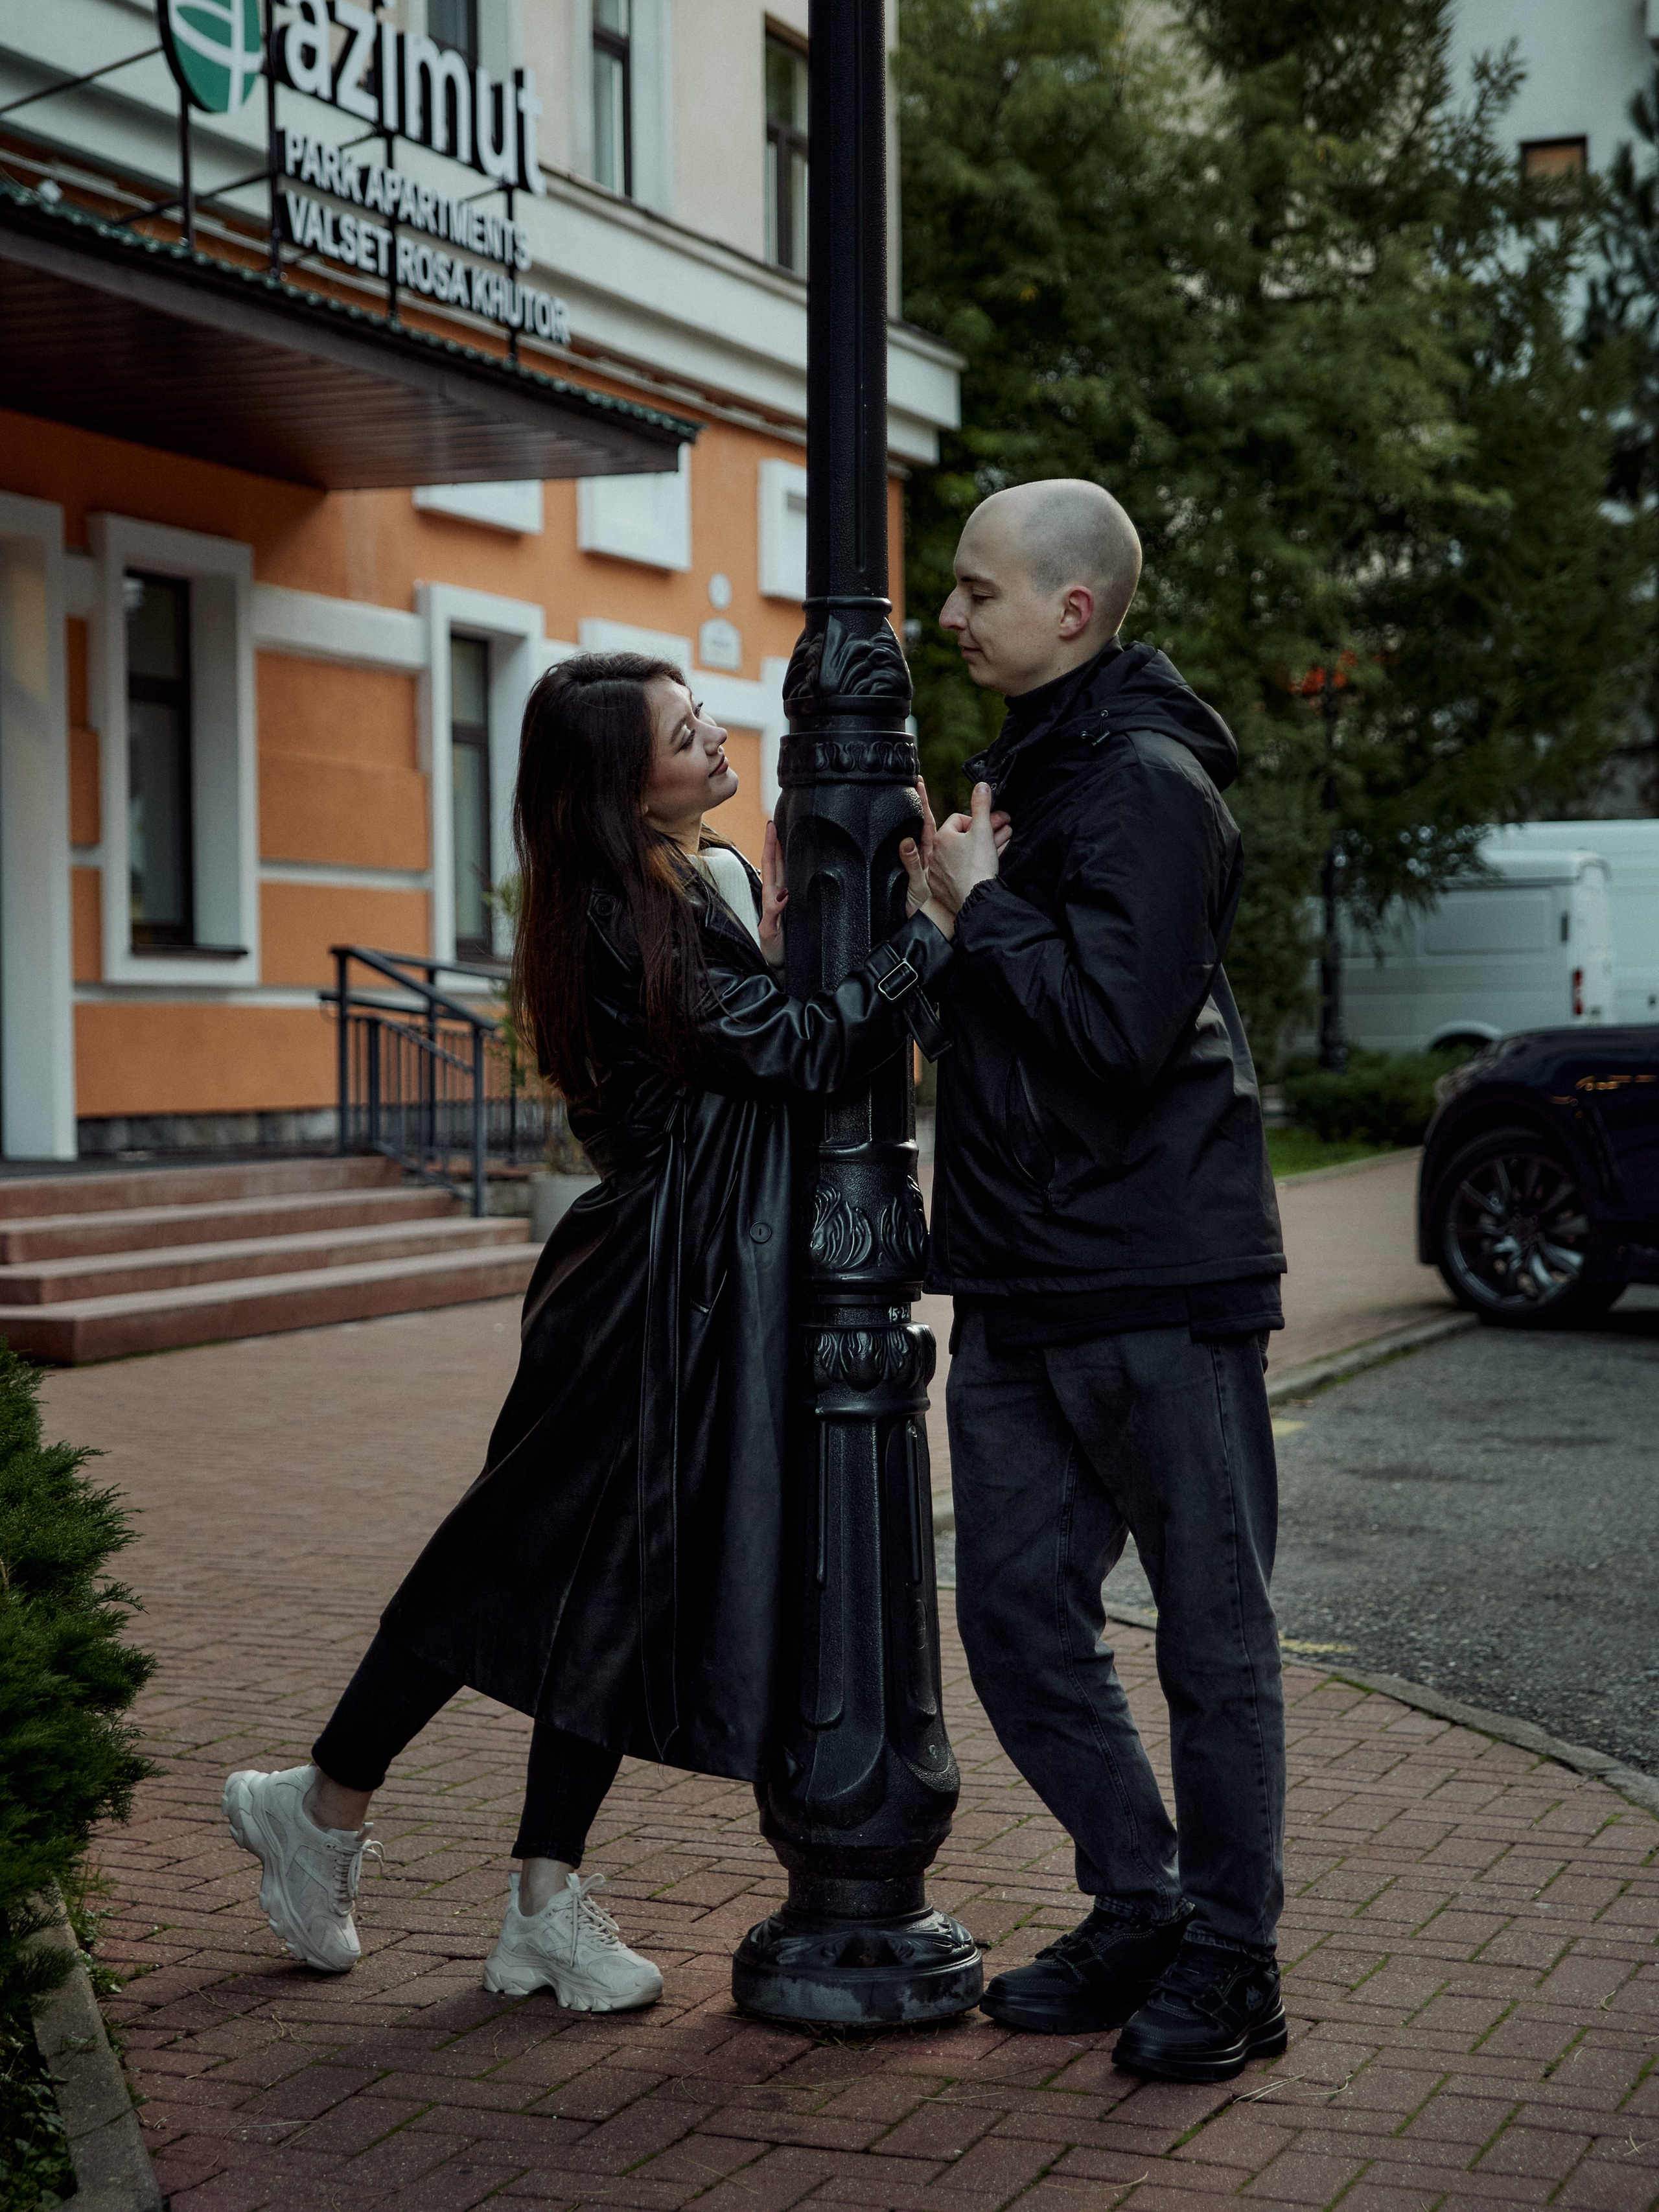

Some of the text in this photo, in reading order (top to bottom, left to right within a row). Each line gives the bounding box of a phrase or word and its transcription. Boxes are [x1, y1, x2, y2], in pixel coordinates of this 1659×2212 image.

[284, 0, 548, 195] azimut
[284, 132, 533, 272] PARK APARTMENTS
[285, 189, 571, 345] VALSET ROSA KHUTOR
